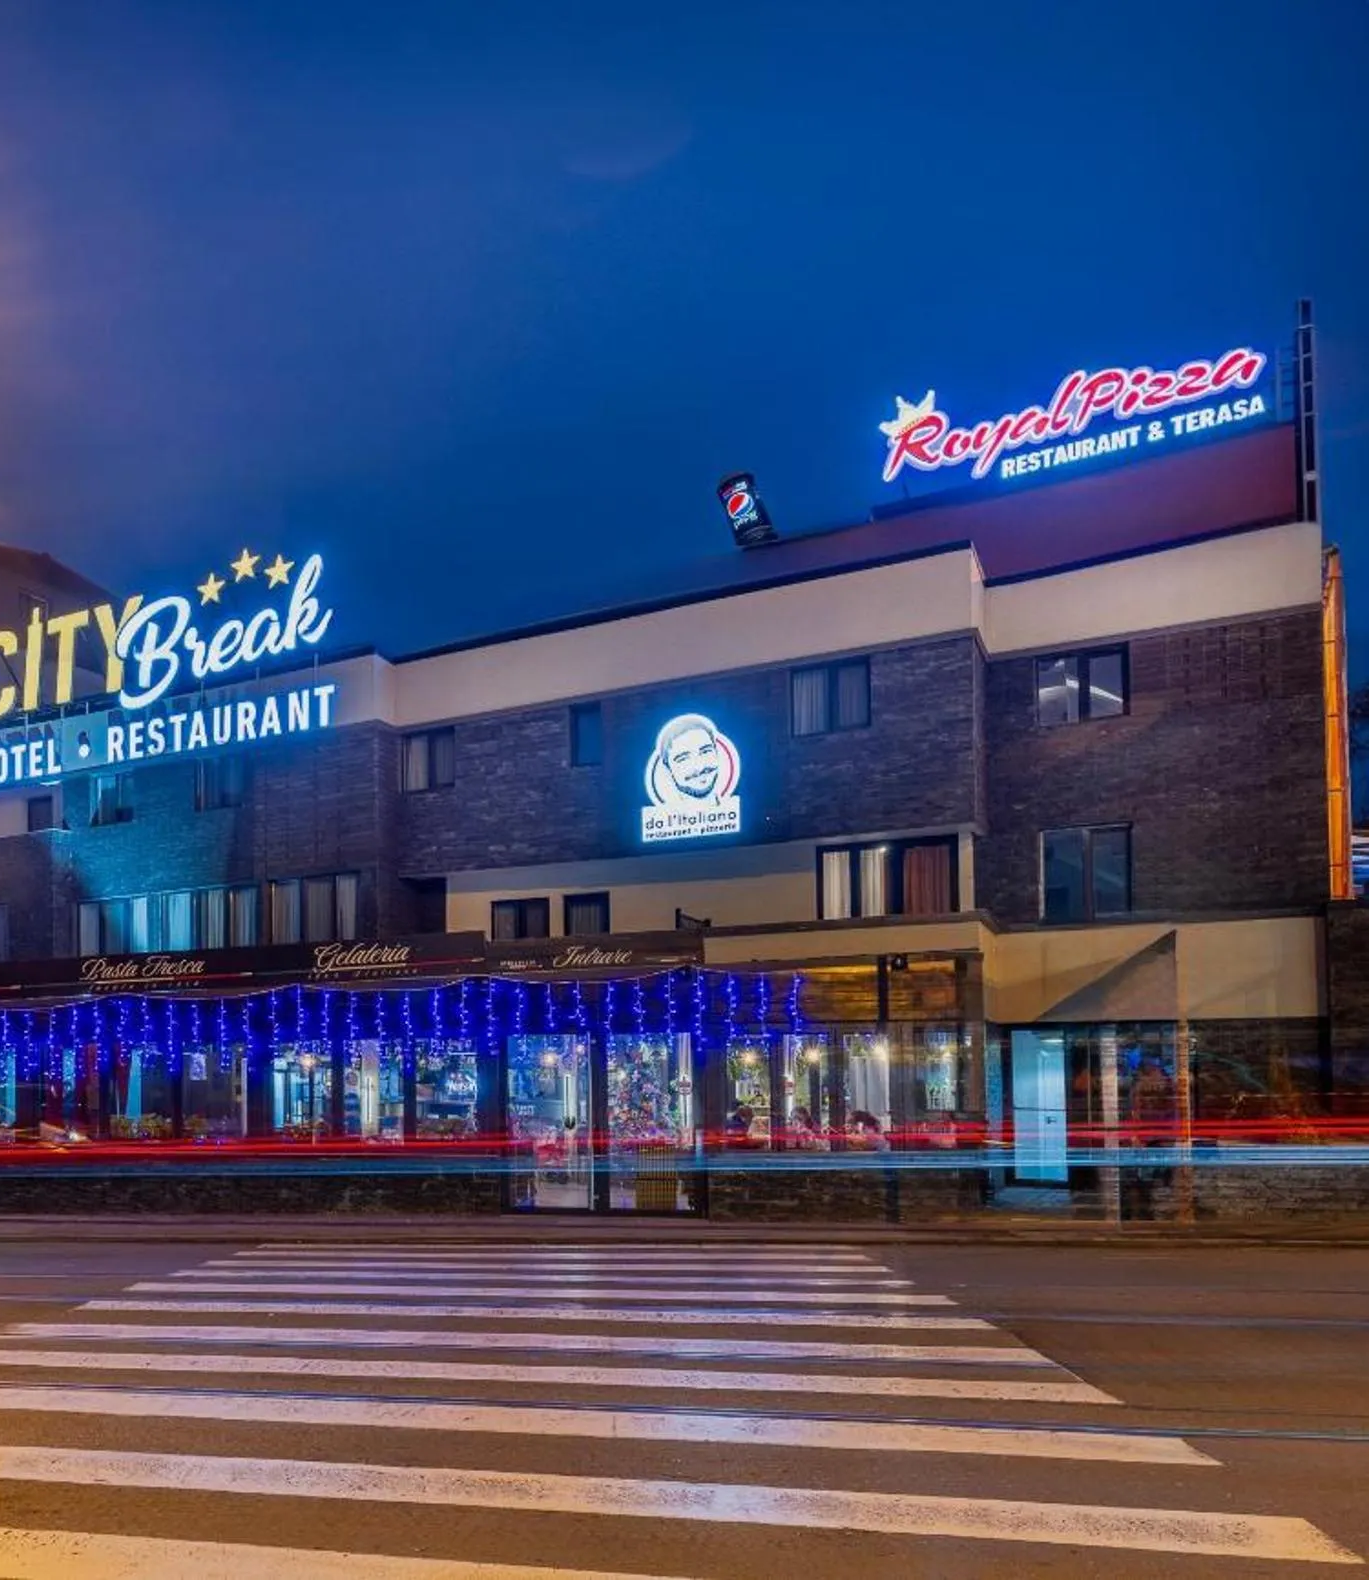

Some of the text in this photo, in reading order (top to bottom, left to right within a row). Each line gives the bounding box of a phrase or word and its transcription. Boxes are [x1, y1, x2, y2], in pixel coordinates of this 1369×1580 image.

[1001, 394, 1266, 479] RESTAURANT & TERASA
[115, 553, 333, 709] Break
[107, 684, 336, 763] RESTAURANT
[79, 956, 139, 980] Pasta
[313, 942, 411, 973] Gelateria
[552, 946, 633, 968] Intrare
